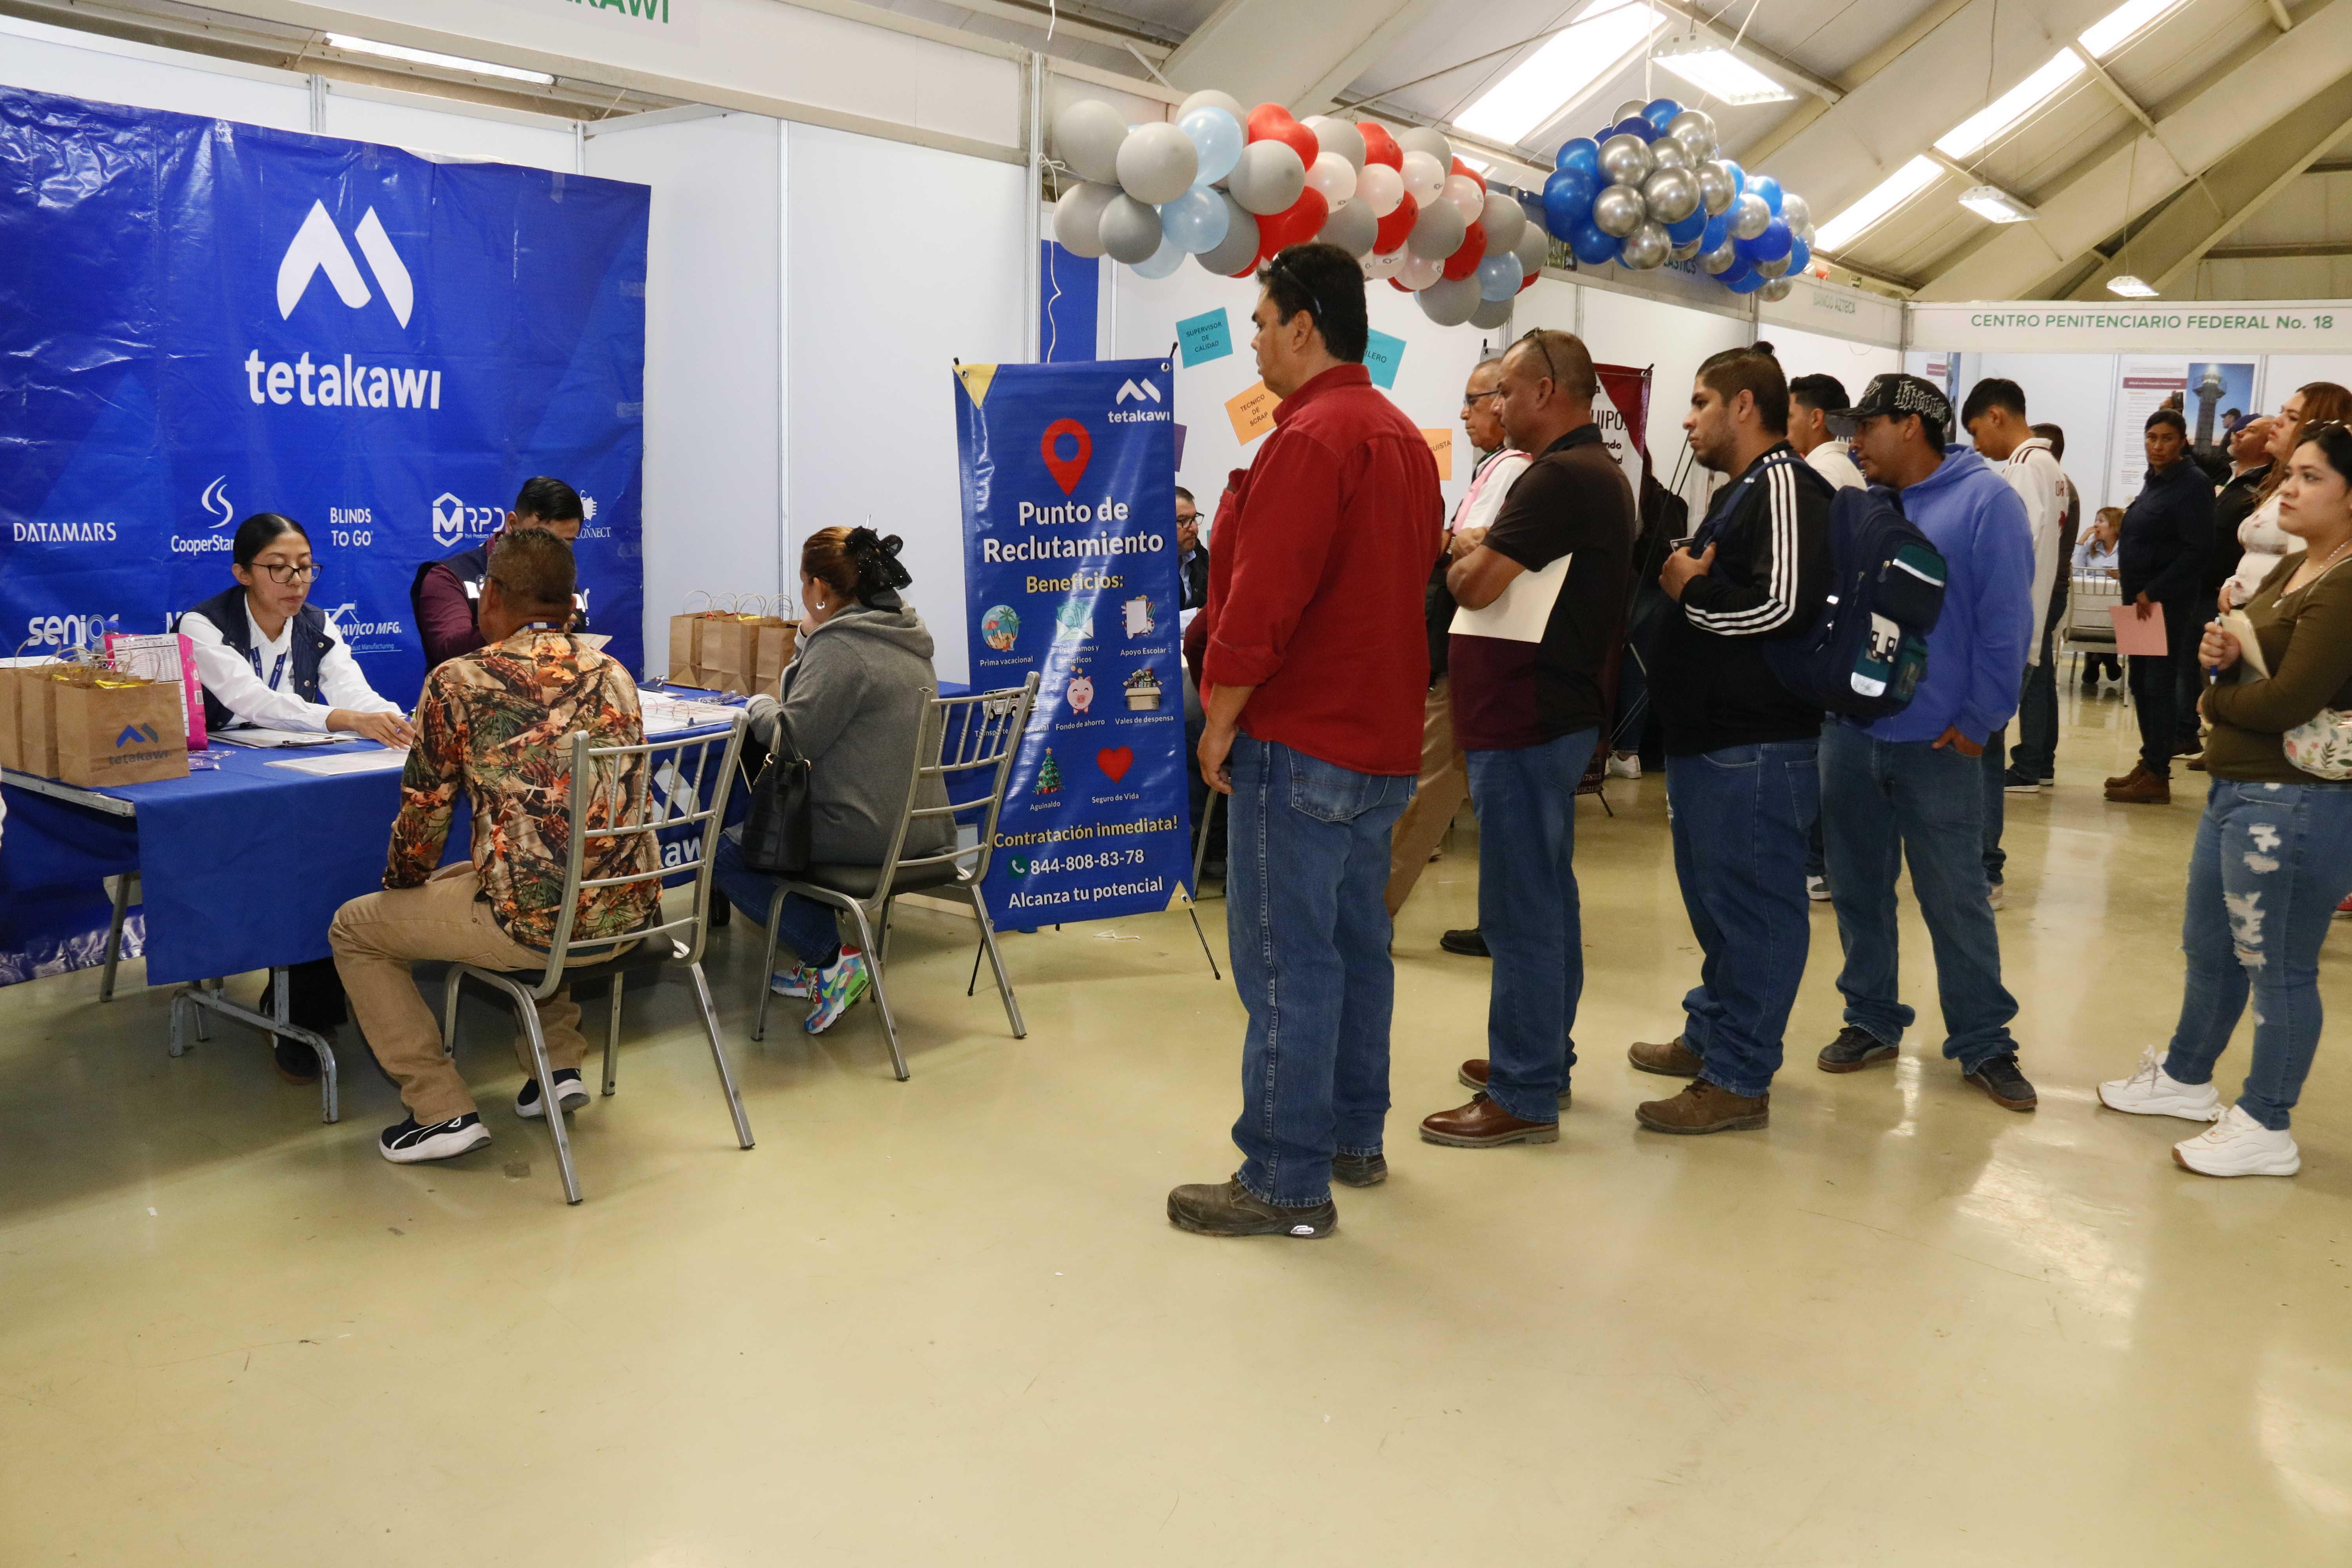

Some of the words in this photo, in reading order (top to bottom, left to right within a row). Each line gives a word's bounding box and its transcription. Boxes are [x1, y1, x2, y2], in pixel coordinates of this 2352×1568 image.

[1186, 320, 1223, 337] SUPERVISOR
[1971, 314, 2040, 328] CENTRO
[2045, 315, 2181, 329] PENITENCIARIO
[2186, 316, 2270, 330] FEDERAL
[2276, 316, 2307, 330] No.
[2313, 316, 2333, 330] 18
[1194, 340, 1220, 353] CALIDAD
[245, 348, 441, 410] tetakawi
[1240, 393, 1266, 413] TECNICO
[1251, 407, 1261, 416] DE
[1108, 409, 1170, 423] tetakawi
[1249, 411, 1269, 427] SCRAP
[330, 507, 371, 524] BLINDS
[1019, 501, 1091, 526] Punto
[1098, 497, 1129, 522] de
[13, 522, 117, 542] DATAMARS
[331, 530, 349, 546] TO
[983, 531, 1164, 563] Reclutamiento
[1026, 573, 1124, 593] Beneficios:
[375, 621, 402, 634] MFG.
[1000, 655, 1033, 665] vacacional
[1055, 721, 1075, 731] Fondo
[1143, 716, 1174, 724] despensa
[108, 749, 170, 766] tetakawi
[1030, 800, 1061, 811] Aguinaldo
[993, 824, 1093, 848] Contratación
[1097, 815, 1178, 837] inmediata!
[1030, 849, 1145, 875] 844-808-83-78
[1008, 890, 1071, 909] Alcanza
[1073, 886, 1090, 902] tu
[1093, 875, 1163, 902] potencial
